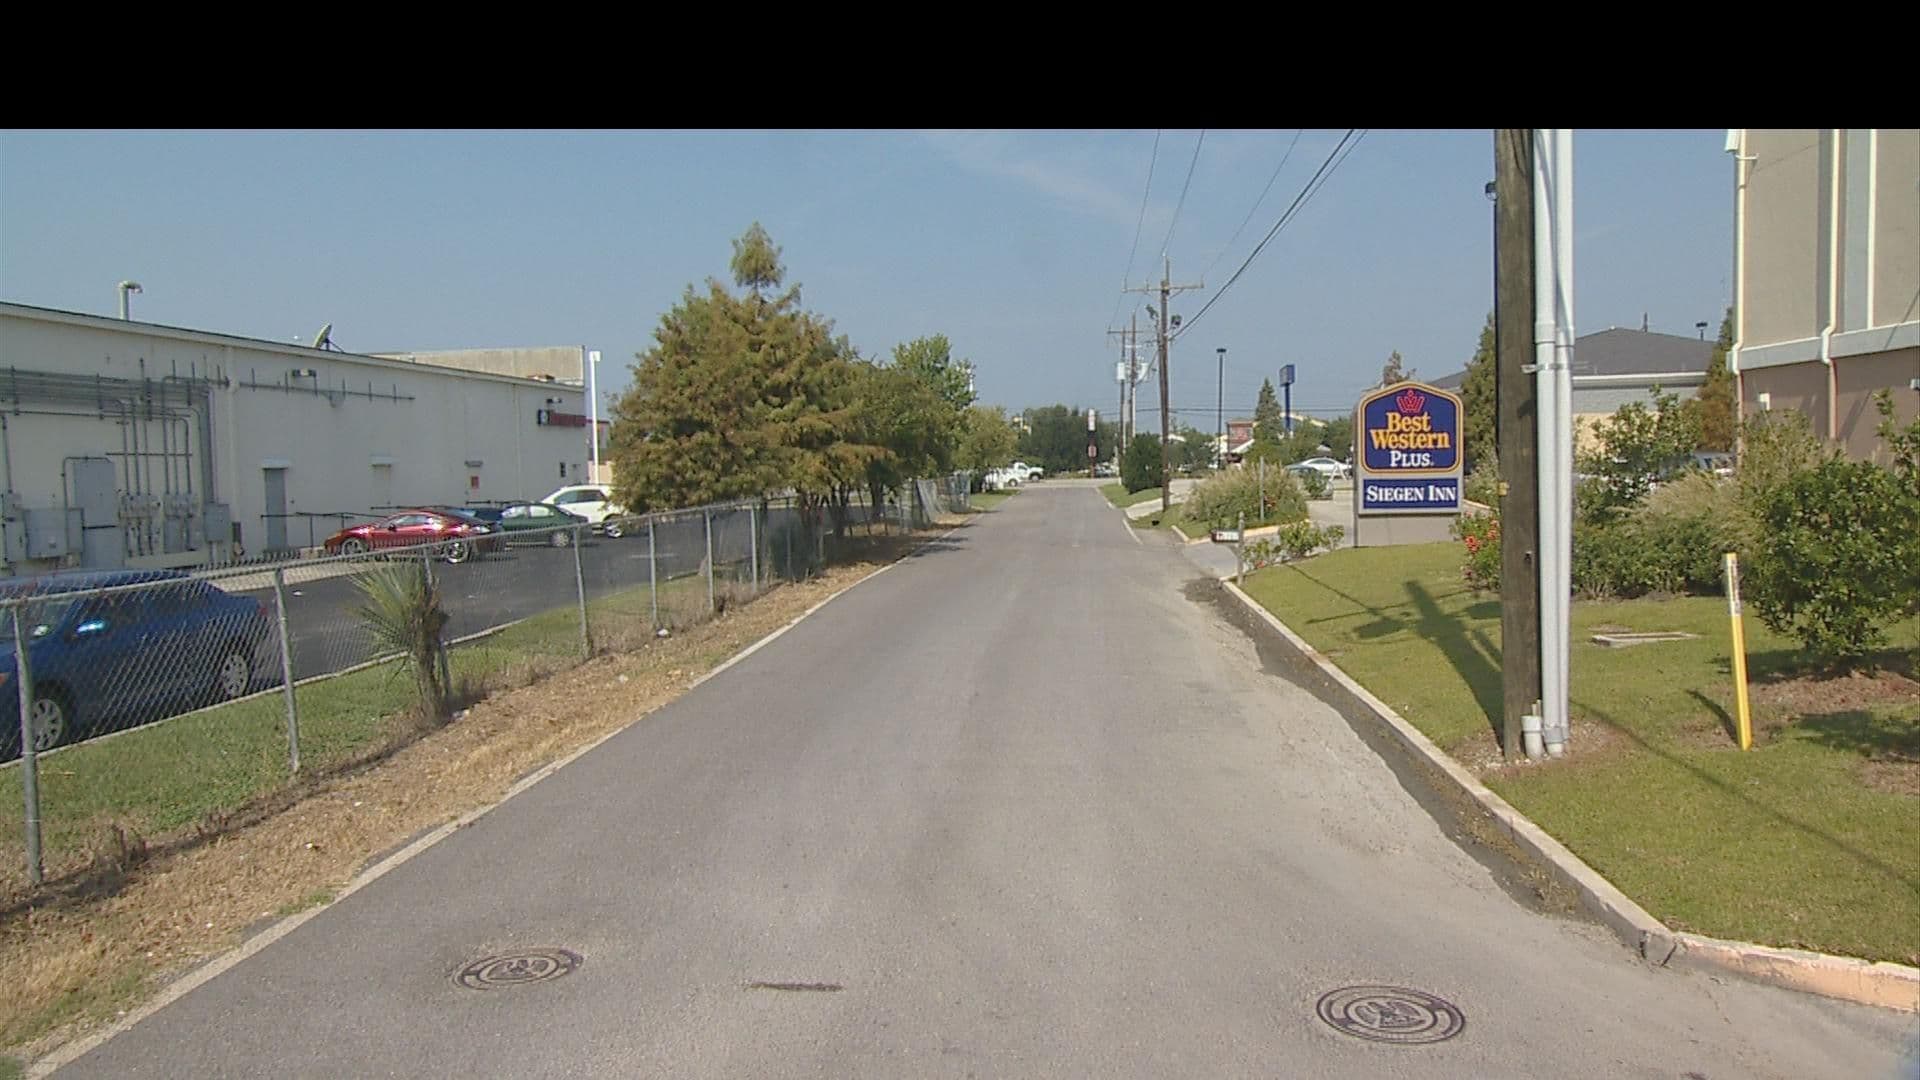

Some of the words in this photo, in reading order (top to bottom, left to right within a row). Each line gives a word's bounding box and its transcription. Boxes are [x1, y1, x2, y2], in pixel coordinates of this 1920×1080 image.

[1386, 411, 1432, 432] Best
[1369, 429, 1451, 450] Western
[1389, 450, 1431, 467] PLUS
[1366, 485, 1425, 502] SIEGEN
[1428, 485, 1457, 502] INN
